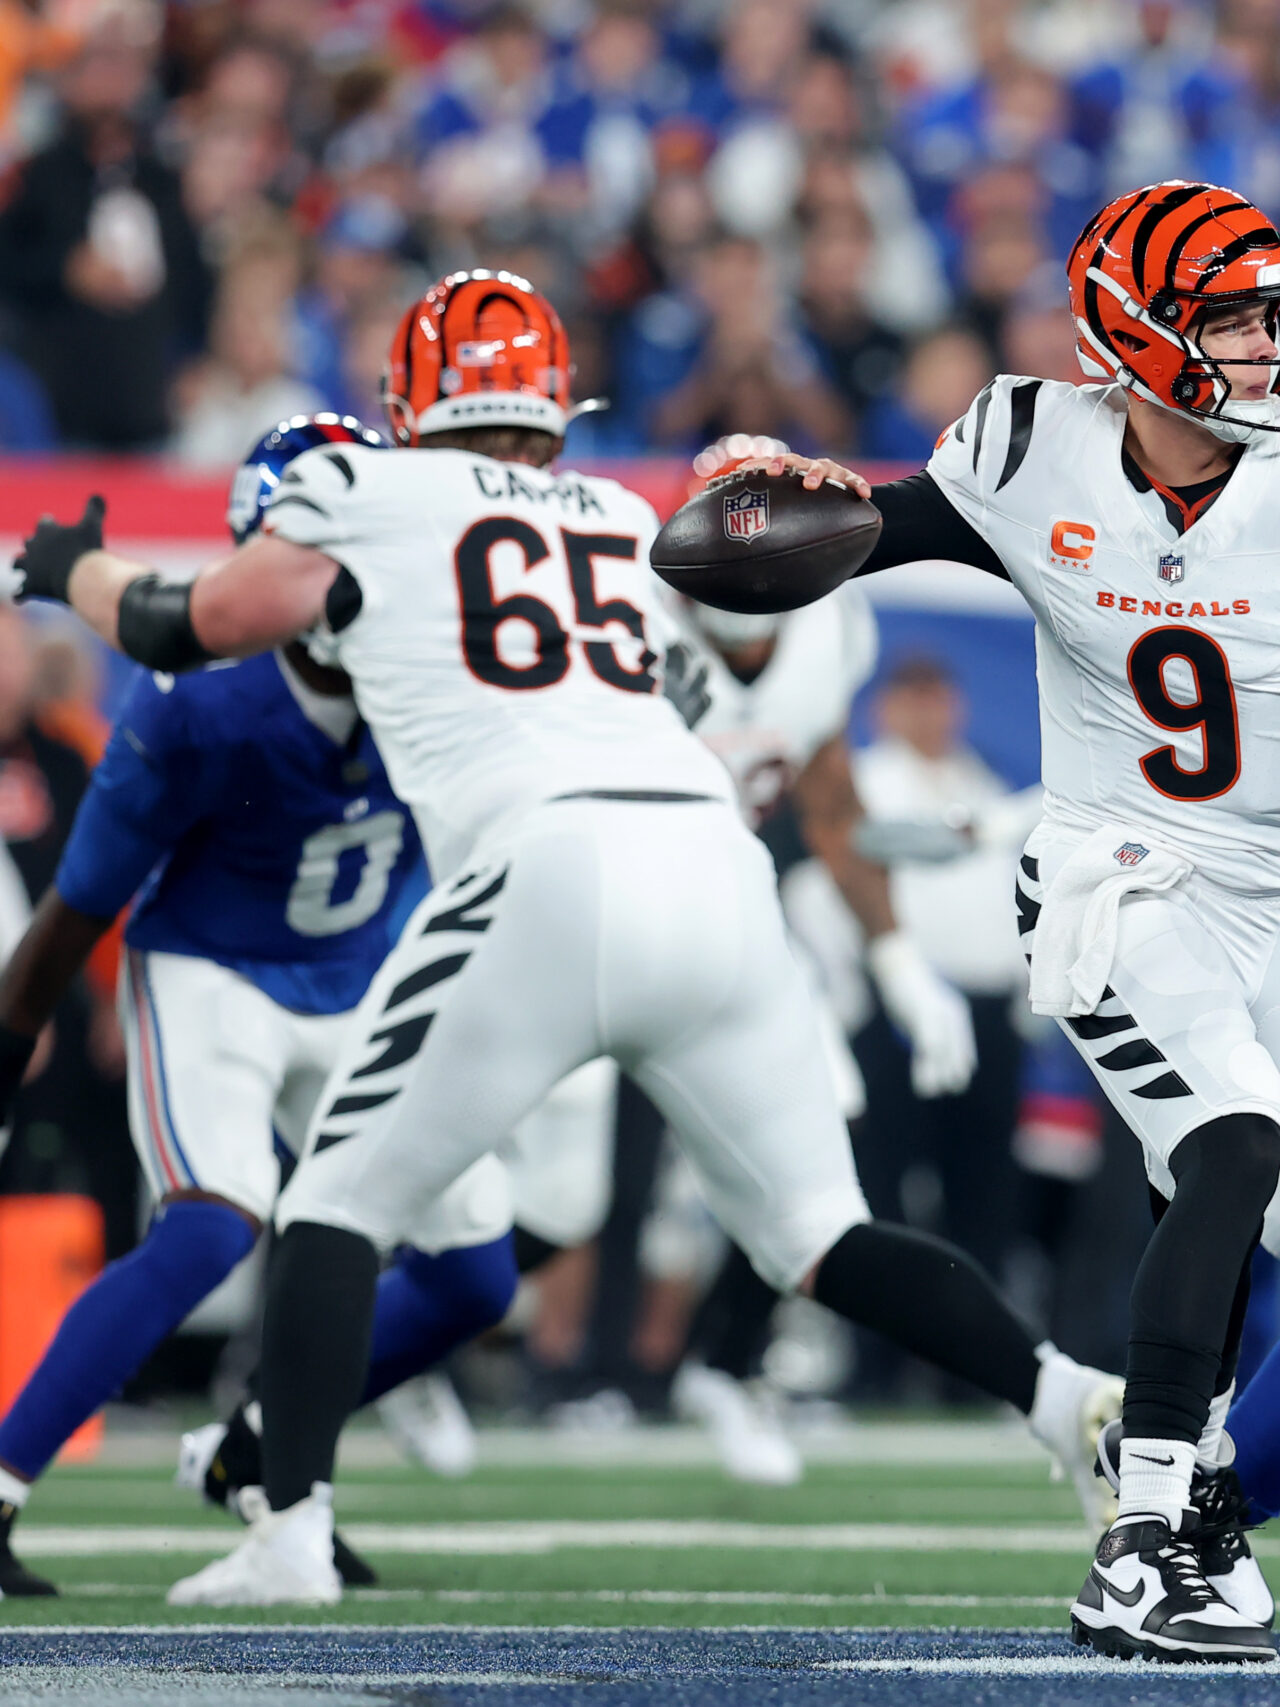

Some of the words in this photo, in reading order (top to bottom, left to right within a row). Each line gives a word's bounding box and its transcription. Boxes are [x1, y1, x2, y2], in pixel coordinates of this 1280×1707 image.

[728, 507, 766, 536] NFL
[1050, 519, 1096, 560] C
[1160, 565, 1181, 580] NFL
[454, 514, 658, 695] 65
[1096, 590, 1252, 618] BENGALS
[1126, 624, 1242, 803] 9
[285, 811, 405, 938] 0
[1116, 848, 1140, 866] NFL
